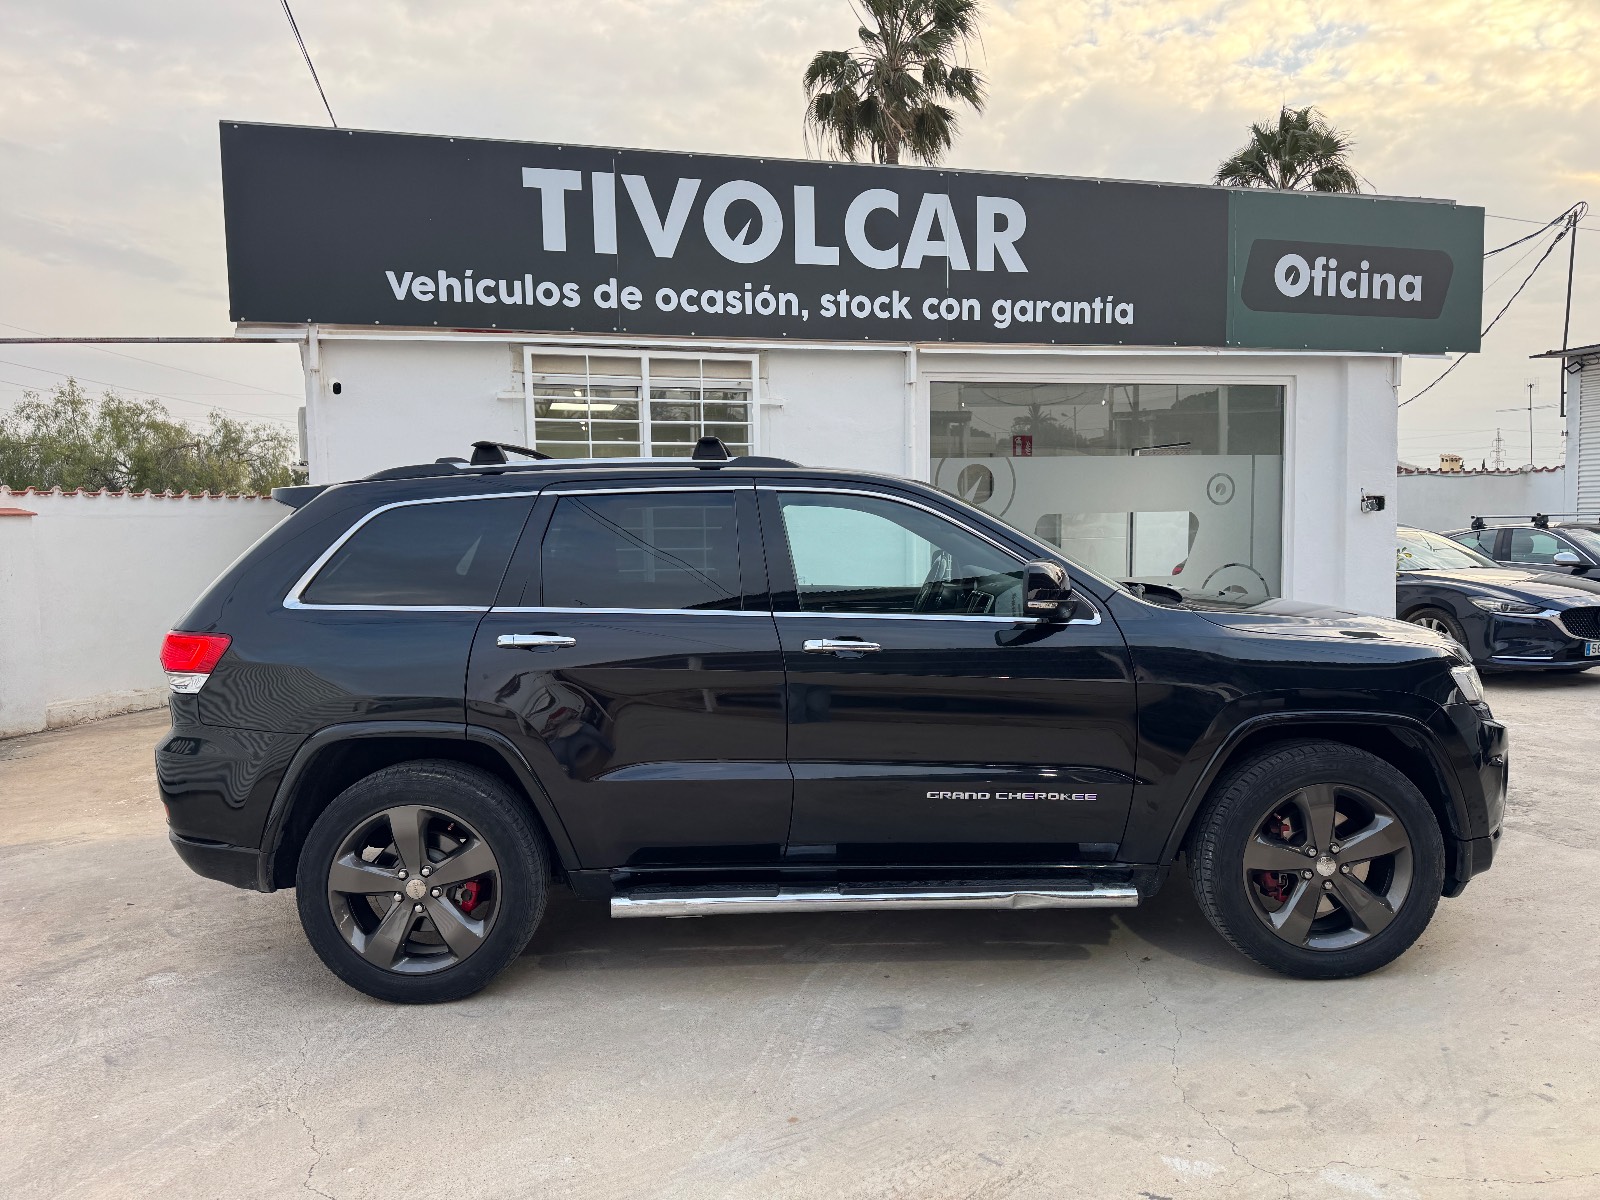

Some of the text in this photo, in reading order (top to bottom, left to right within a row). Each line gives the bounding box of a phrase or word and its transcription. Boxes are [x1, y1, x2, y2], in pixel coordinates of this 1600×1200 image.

[522, 167, 1028, 272] TIVOLCAR
[386, 270, 1133, 328] Vehículos de ocasión, stock con garantía
[1274, 254, 1423, 301] Oficina
[926, 791, 1098, 801] GRAND CHEROKEE
